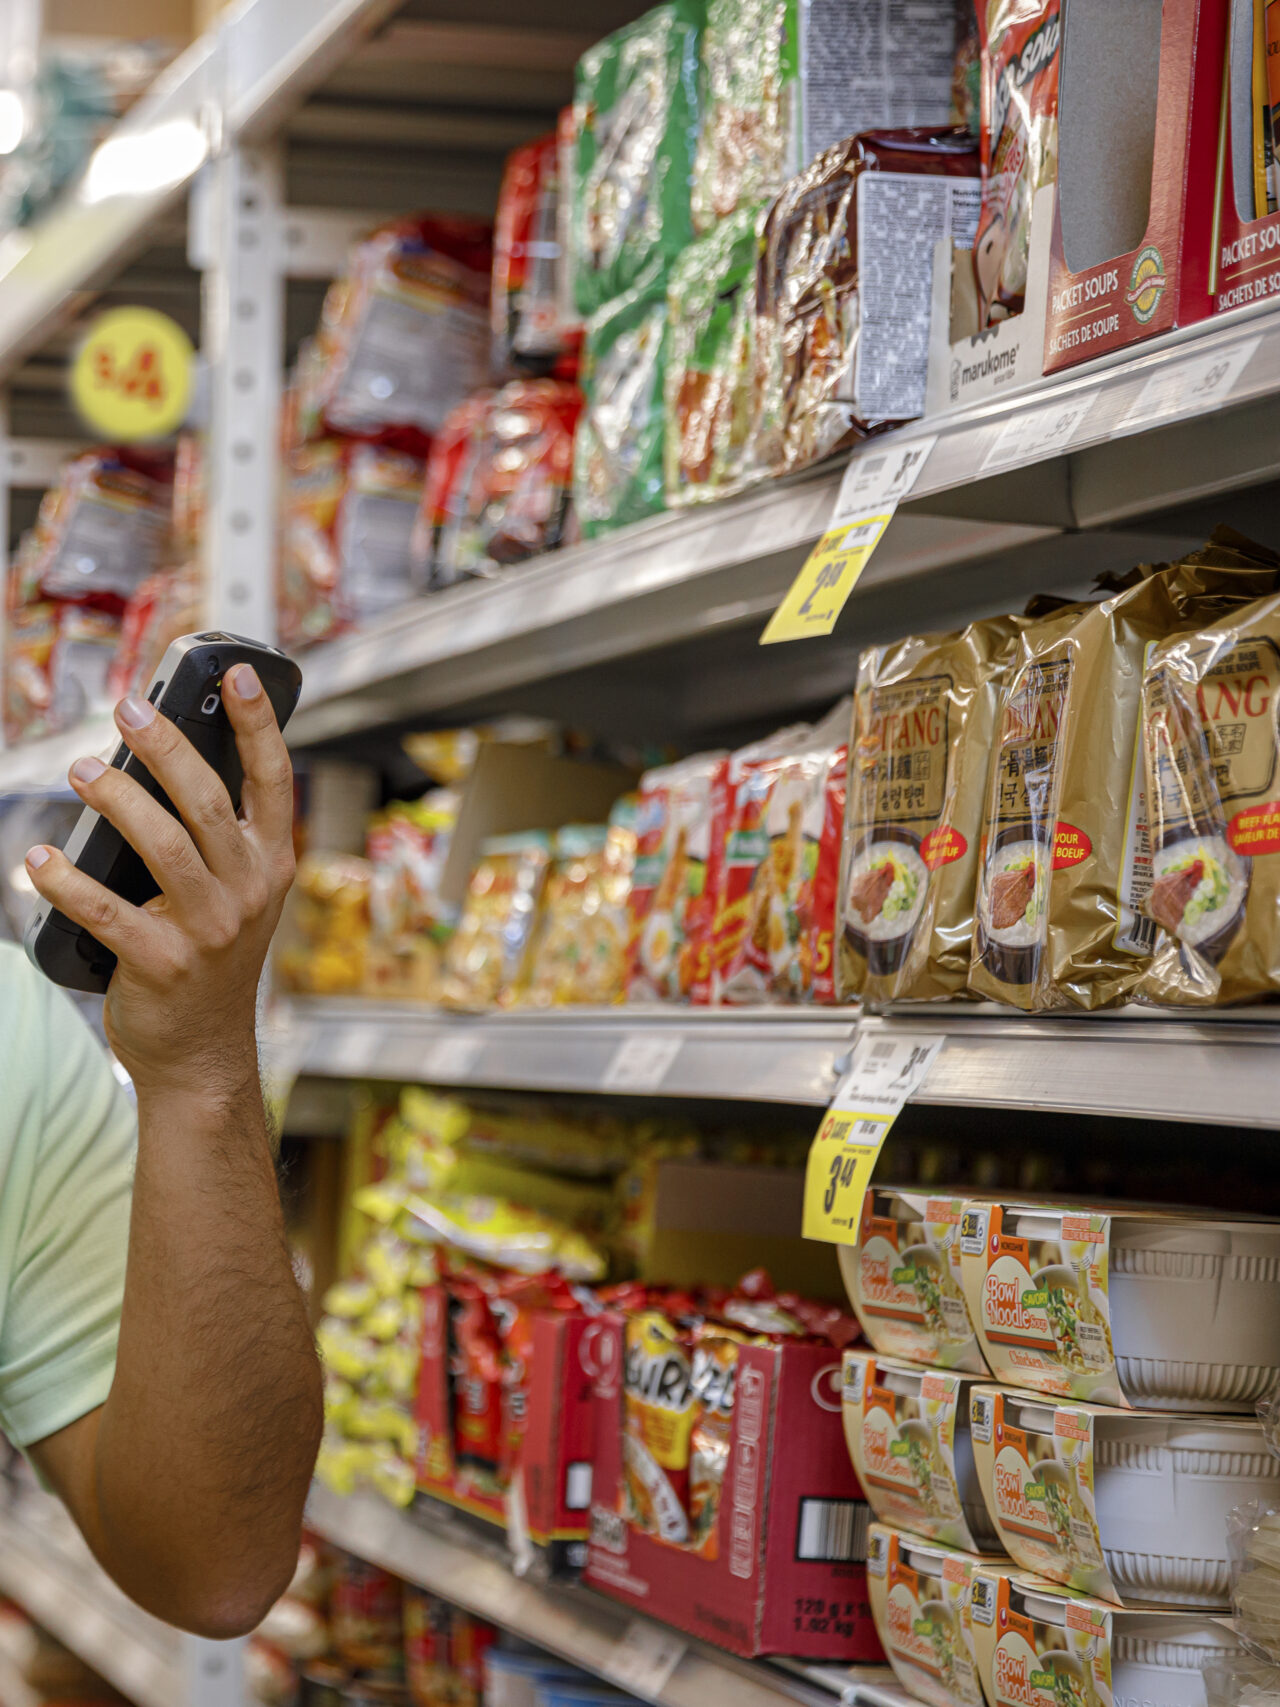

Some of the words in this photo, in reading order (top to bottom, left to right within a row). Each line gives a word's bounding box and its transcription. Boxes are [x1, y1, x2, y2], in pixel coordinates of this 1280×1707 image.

[1221, 233, 1258, 269] PACKET
[1051, 283, 1084, 315] PACKET
[1085, 269, 1119, 302] SOUPS
[1218, 282, 1253, 312] SACHETS
[1255, 277, 1267, 298] DE
[1049, 330, 1080, 355] SACHETS
[1081, 327, 1091, 342] DE
[1092, 313, 1120, 338] SOUPE
[961, 347, 1017, 386] marukome
[1233, 830, 1266, 846] SAVEUR
[1267, 826, 1280, 840] DE
[1238, 816, 1260, 829] BEEF
[1056, 846, 1085, 858] BOEUF
[985, 1274, 1020, 1301] Bowl
[1022, 1292, 1049, 1306] SAVORY
[985, 1299, 1031, 1329] Noodle
[996, 1647, 1027, 1682] Bowl
[996, 1670, 1040, 1704] Noodle
